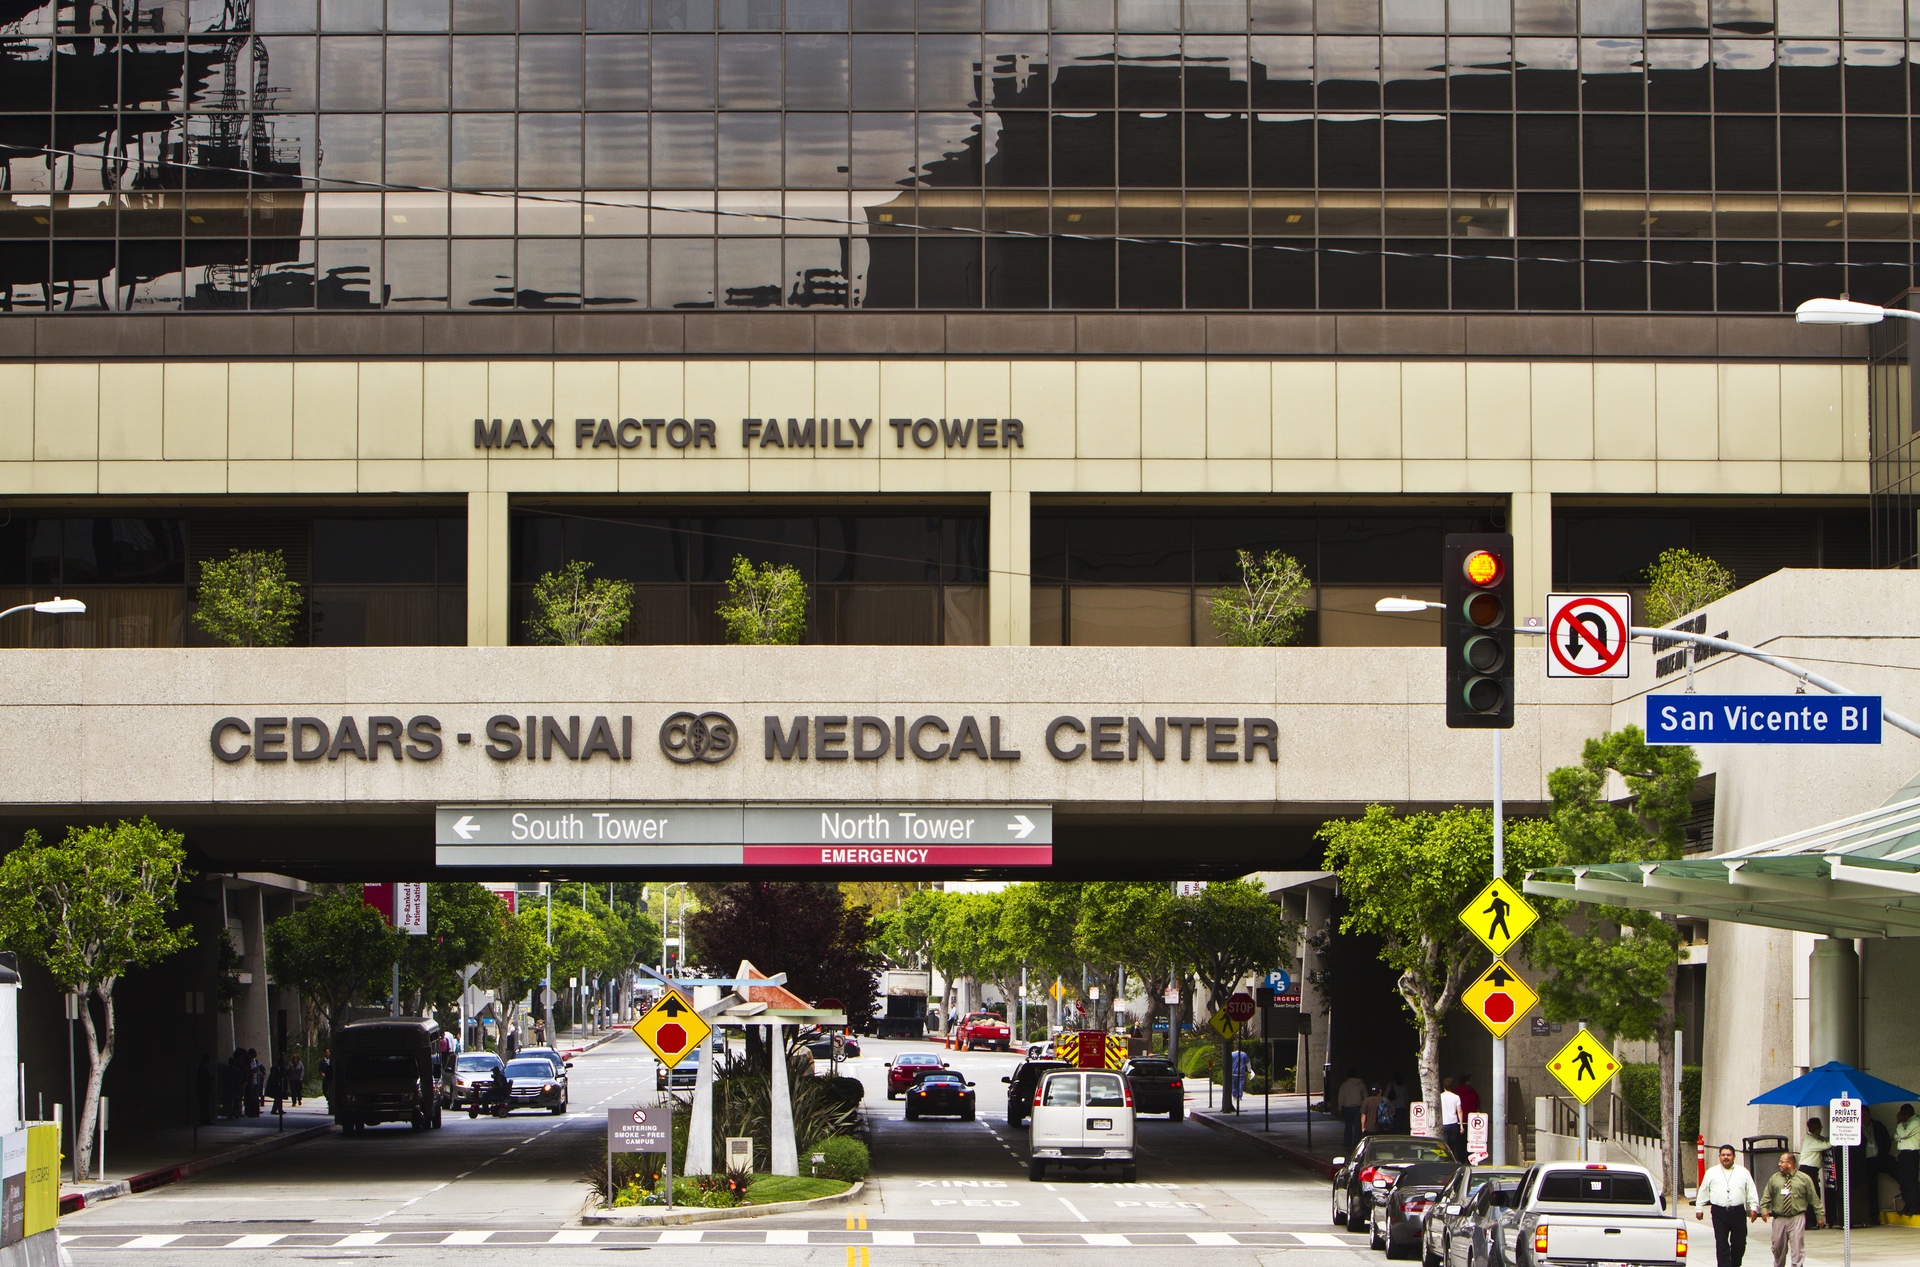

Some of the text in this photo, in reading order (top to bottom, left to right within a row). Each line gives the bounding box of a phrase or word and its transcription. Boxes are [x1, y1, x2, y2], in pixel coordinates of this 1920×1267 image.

[474, 418, 1025, 449] MAX FACTOR FAMILY TOWER
[1661, 706, 1868, 731] San Vicente Bl
[210, 715, 443, 763] CEDARS
[485, 715, 633, 762] SINAI
[764, 715, 1021, 762] MEDICAL
[1045, 716, 1279, 763] CENTER
[510, 812, 668, 840] South Tower
[821, 812, 975, 840] North Tower
[821, 848, 929, 864] EMERGENCY
[404, 888, 412, 926] Top-Ranked
[1270, 972, 1282, 984] P
[1276, 981, 1286, 992] 5
[1228, 1001, 1254, 1014] STOP
[1070, 1040, 1076, 1048] 7
[914, 1179, 1008, 1188] XING
[1088, 1181, 1182, 1190] XING
[930, 1199, 1022, 1208] PED
[1113, 1200, 1207, 1209] PED
